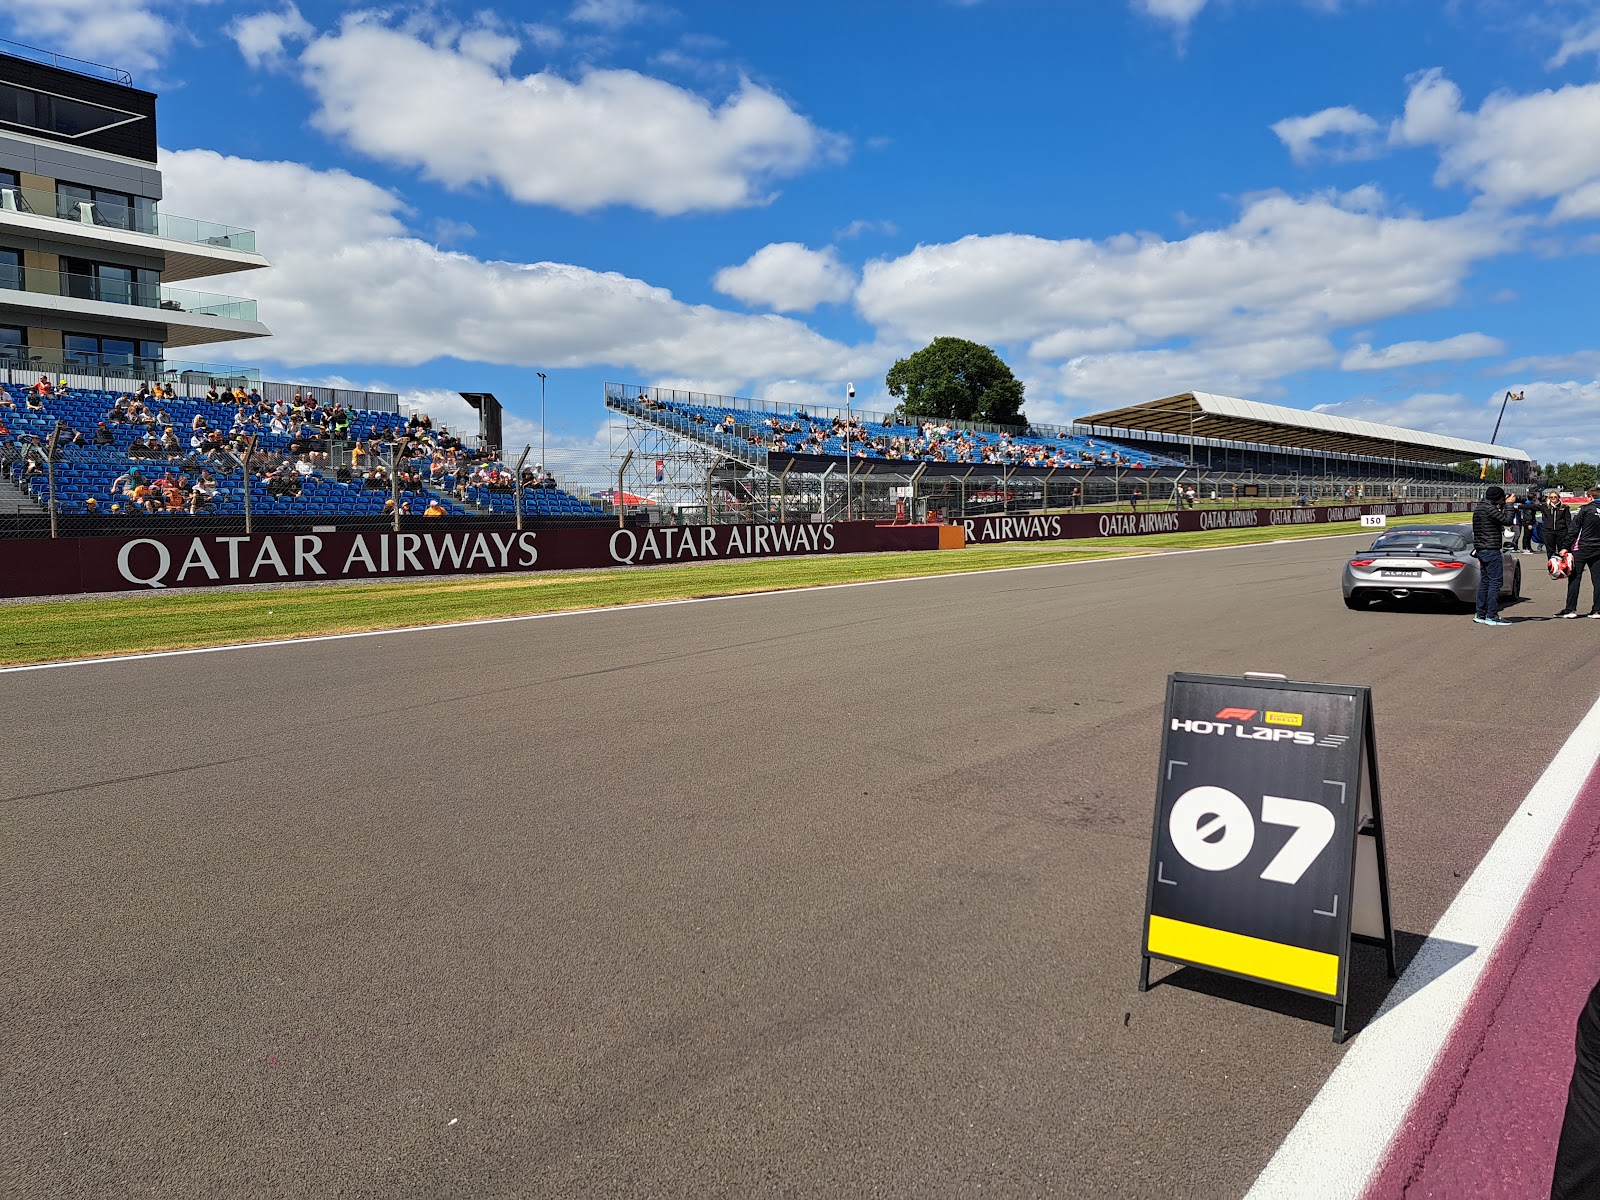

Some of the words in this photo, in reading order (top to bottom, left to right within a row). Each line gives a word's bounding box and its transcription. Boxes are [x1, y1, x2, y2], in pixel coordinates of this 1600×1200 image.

[981, 515, 1061, 540] AIRWAYS
[1099, 514, 1136, 536] QATAR
[1138, 512, 1179, 532] AIRWAYS
[1200, 511, 1227, 530] QATAR
[1228, 510, 1258, 527] AIRWAYS
[1269, 509, 1292, 526] QATAR
[1365, 517, 1382, 525] 150
[609, 526, 718, 565] QATAR
[726, 523, 835, 555] AIRWAYS
[117, 534, 326, 588] QATAR
[343, 531, 538, 573] AIRWAYS
[1171, 718, 1232, 736] HOT
[1269, 713, 1299, 724] PIRELLI
[1169, 785, 1336, 885] 07
